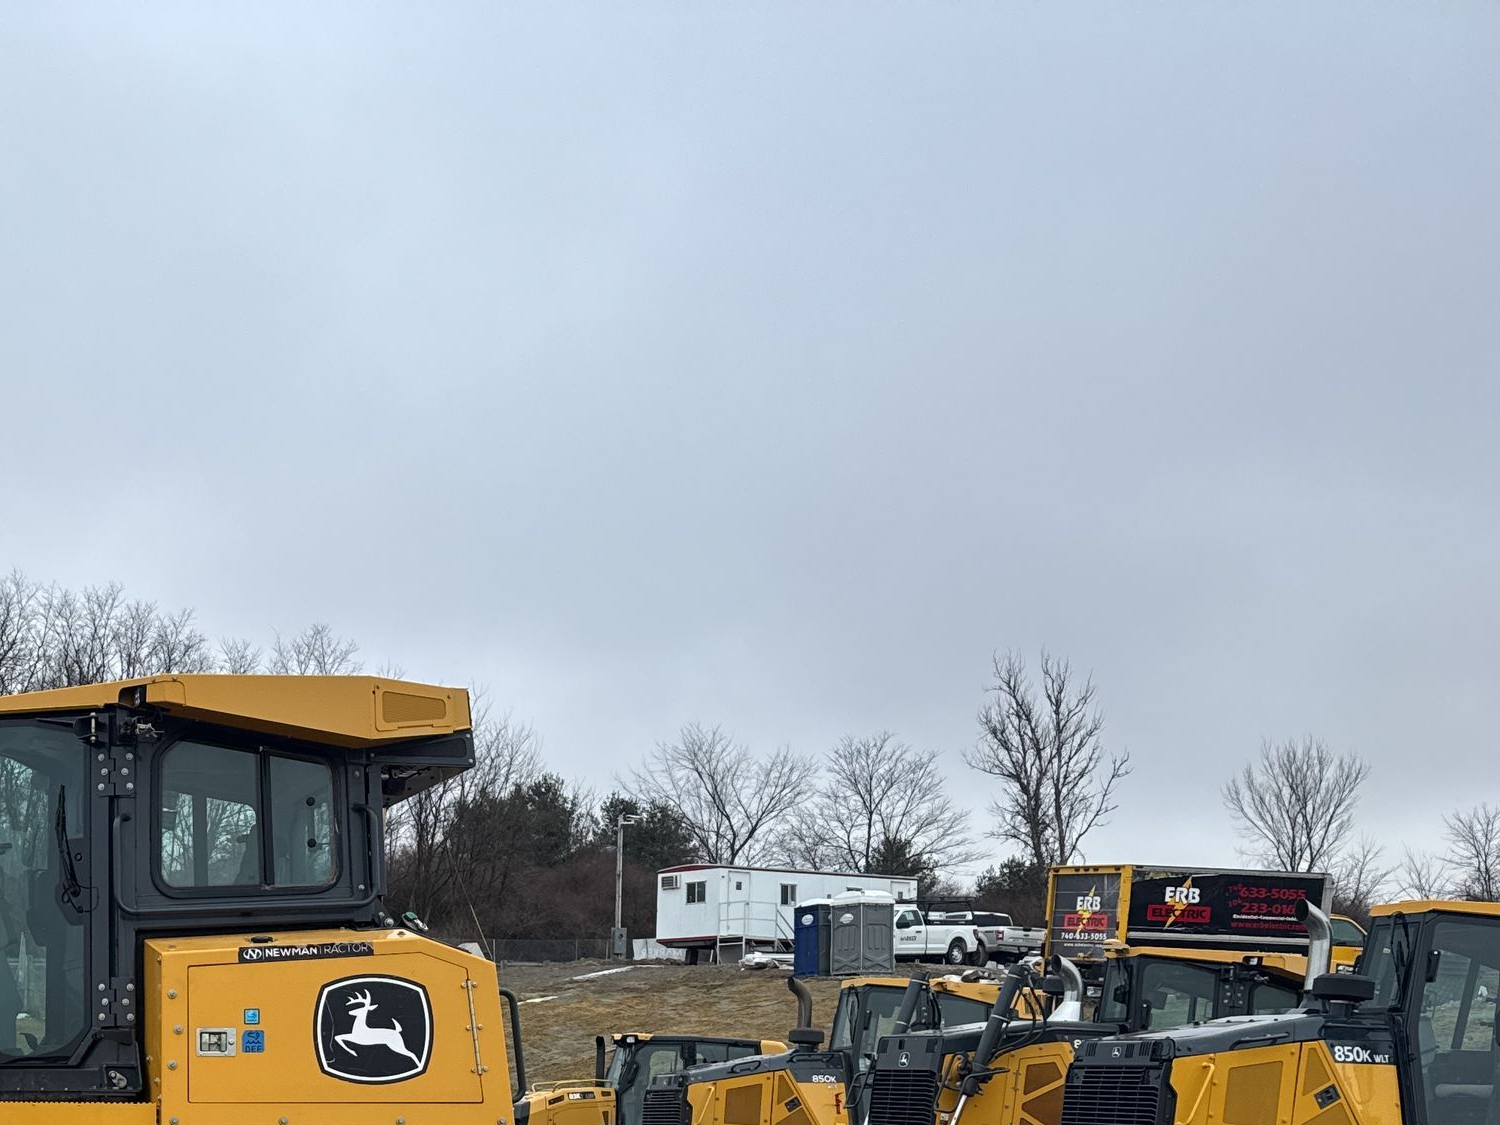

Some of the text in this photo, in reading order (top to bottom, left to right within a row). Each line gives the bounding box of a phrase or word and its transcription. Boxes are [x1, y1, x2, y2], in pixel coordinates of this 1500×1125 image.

[1165, 886, 1201, 904] ERB
[1240, 887, 1306, 899] 633-5055
[1076, 896, 1101, 912] ERB
[1333, 1045, 1390, 1063] 850K WLT
[812, 1074, 837, 1083] 850K
